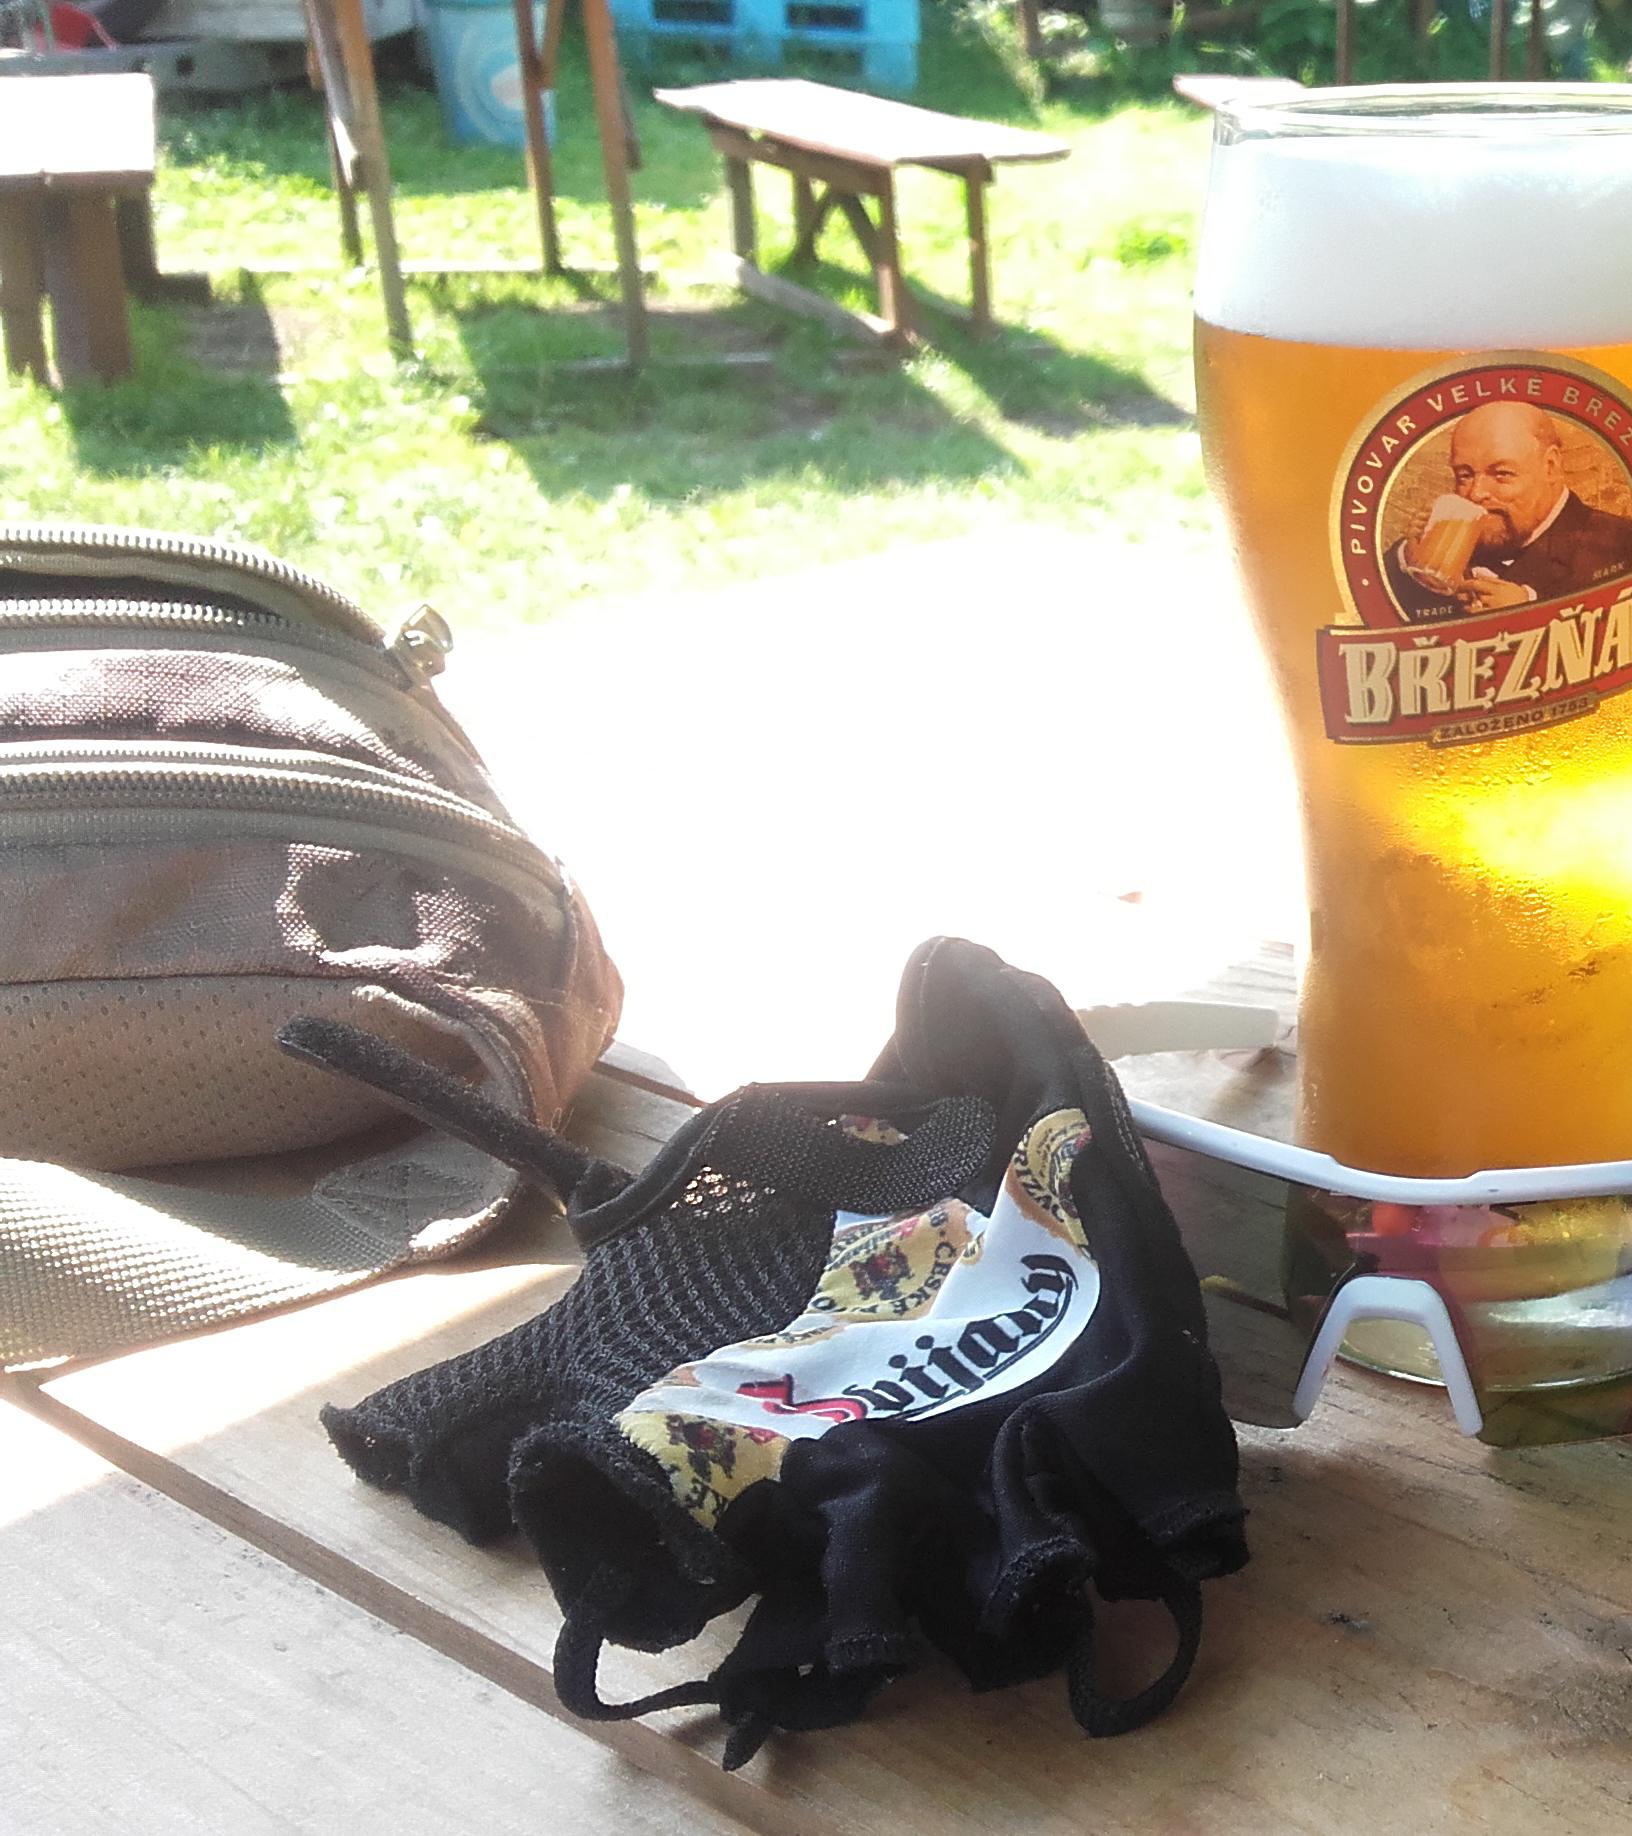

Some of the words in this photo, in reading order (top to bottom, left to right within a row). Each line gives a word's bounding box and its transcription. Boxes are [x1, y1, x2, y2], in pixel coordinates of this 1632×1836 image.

[1349, 414, 1417, 555] PIVOVAR
[1426, 373, 1544, 413] VELKÉ
[1439, 710, 1544, 739] ZALOŽENO
